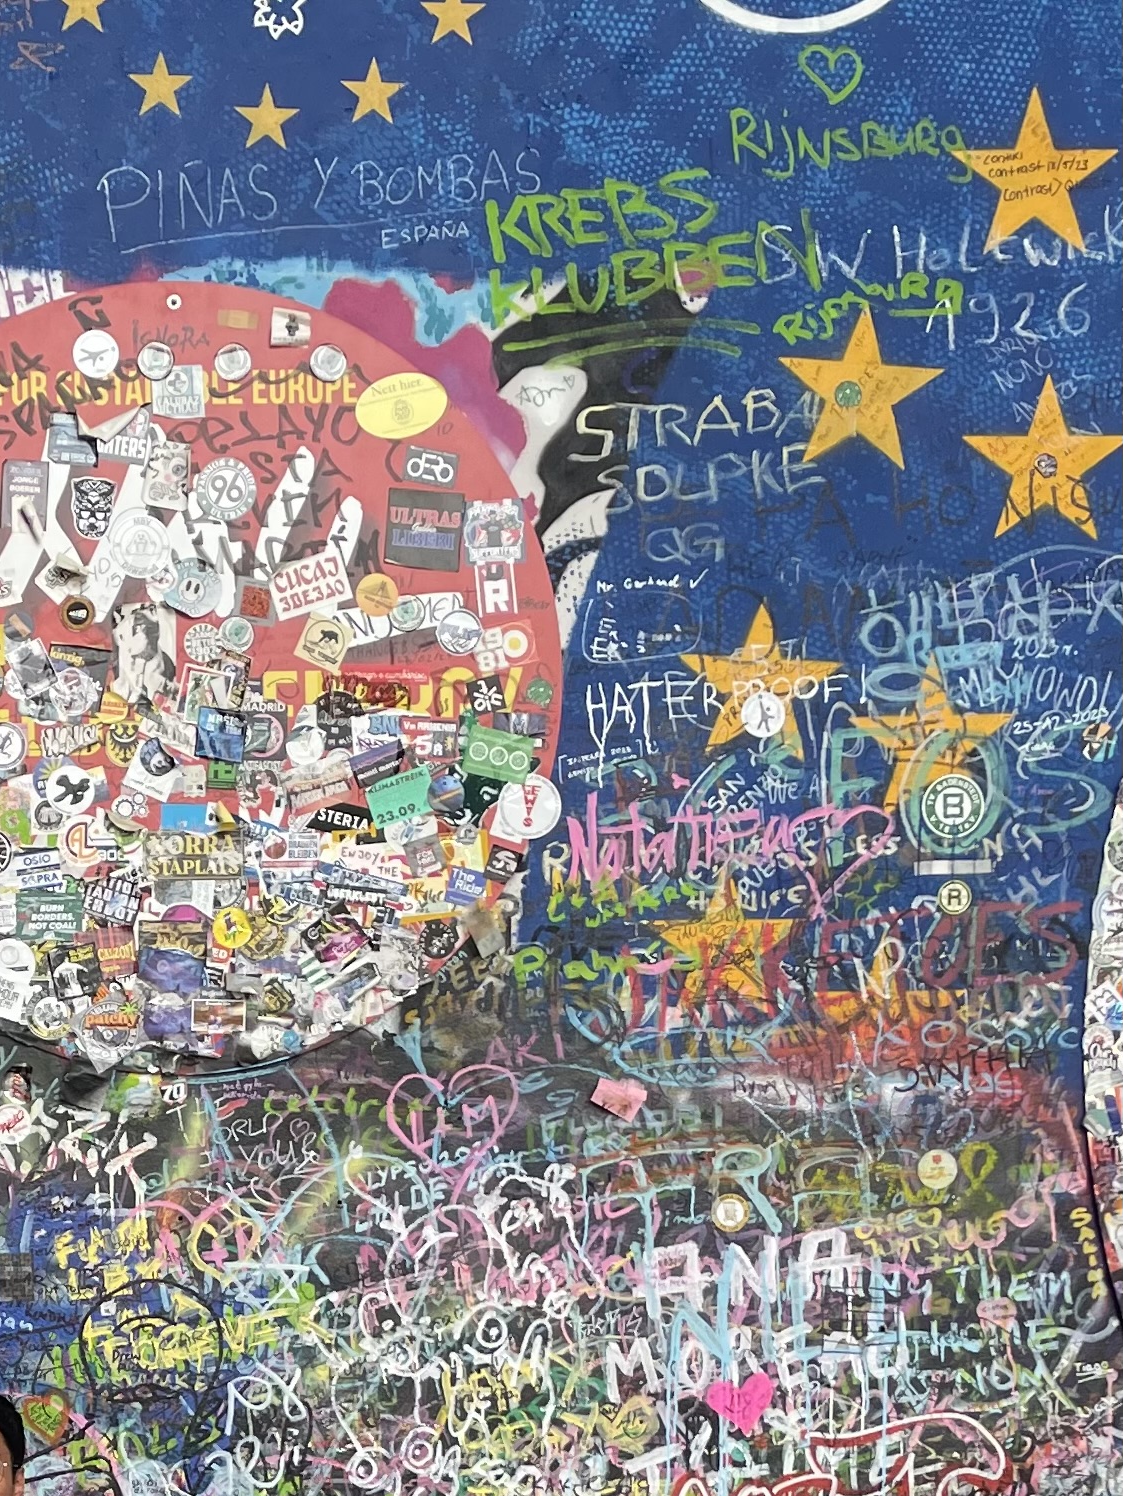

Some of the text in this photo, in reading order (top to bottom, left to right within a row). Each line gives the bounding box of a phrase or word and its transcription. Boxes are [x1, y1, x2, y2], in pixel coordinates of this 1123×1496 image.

[312, 156, 339, 209] Y
[485, 168, 717, 263] KREBS
[390, 506, 461, 527] ULTRAS
[378, 803, 420, 824] 23.09.
[23, 854, 51, 865] OSIO
[377, 866, 399, 877] THE
[40, 904, 65, 912] BURN
[31, 913, 75, 921] BORDERS.
[28, 922, 47, 930] NOT
[85, 1012, 137, 1028] patchy
